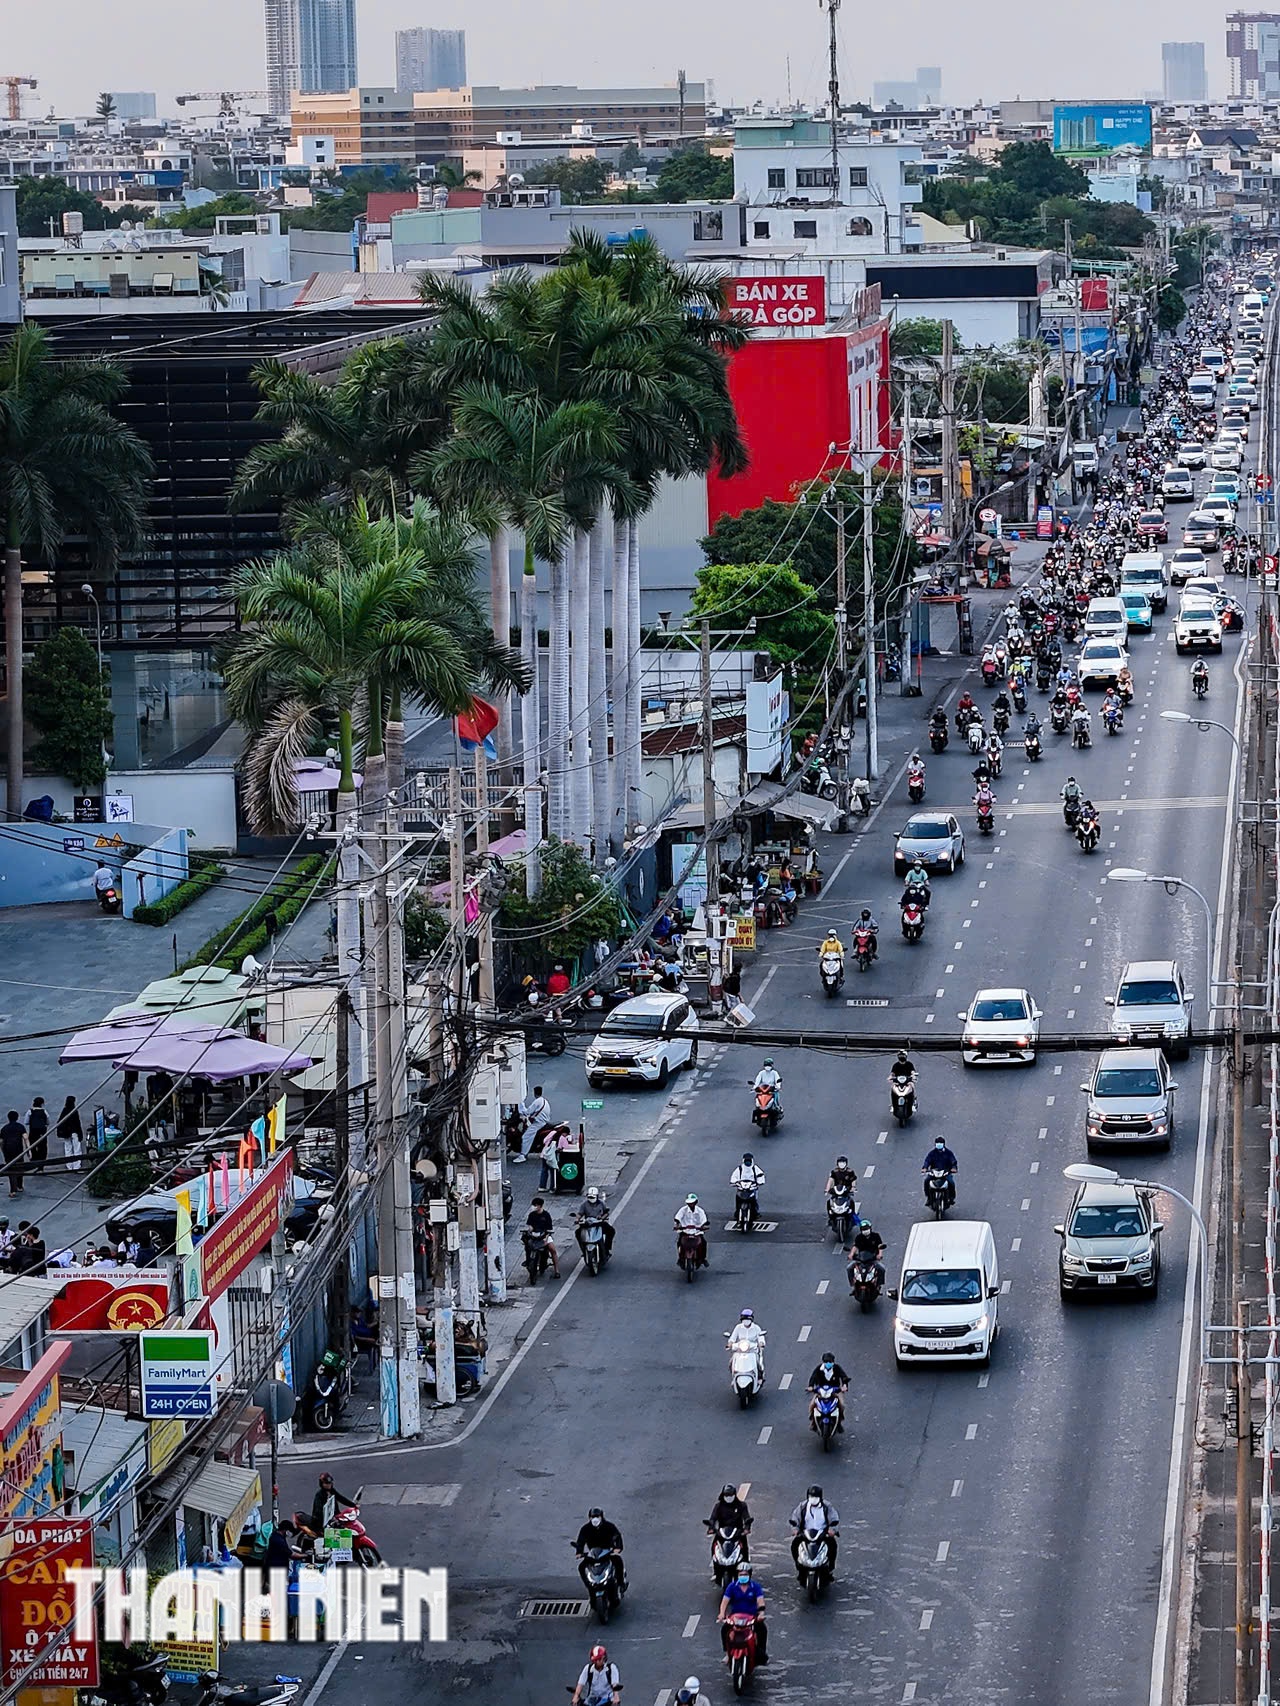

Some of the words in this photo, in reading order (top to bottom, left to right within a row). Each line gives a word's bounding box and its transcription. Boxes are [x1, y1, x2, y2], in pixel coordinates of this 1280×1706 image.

[736, 282, 776, 301] BÁN
[782, 284, 808, 300] XE
[773, 304, 816, 323] GÓP
[148, 1368, 206, 1379] FamilyMart
[151, 1399, 173, 1409] 24H
[176, 1399, 207, 1409] OPEN
[14, 1529, 37, 1543] OA
[41, 1526, 83, 1543] PHÁT
[6, 1546, 84, 1585] CẦM
[21, 1587, 71, 1625] ĐỒ
[26, 1629, 39, 1645] Ô
[47, 1664, 67, 1680] TIỀN
[69, 1667, 88, 1680] 24/7
